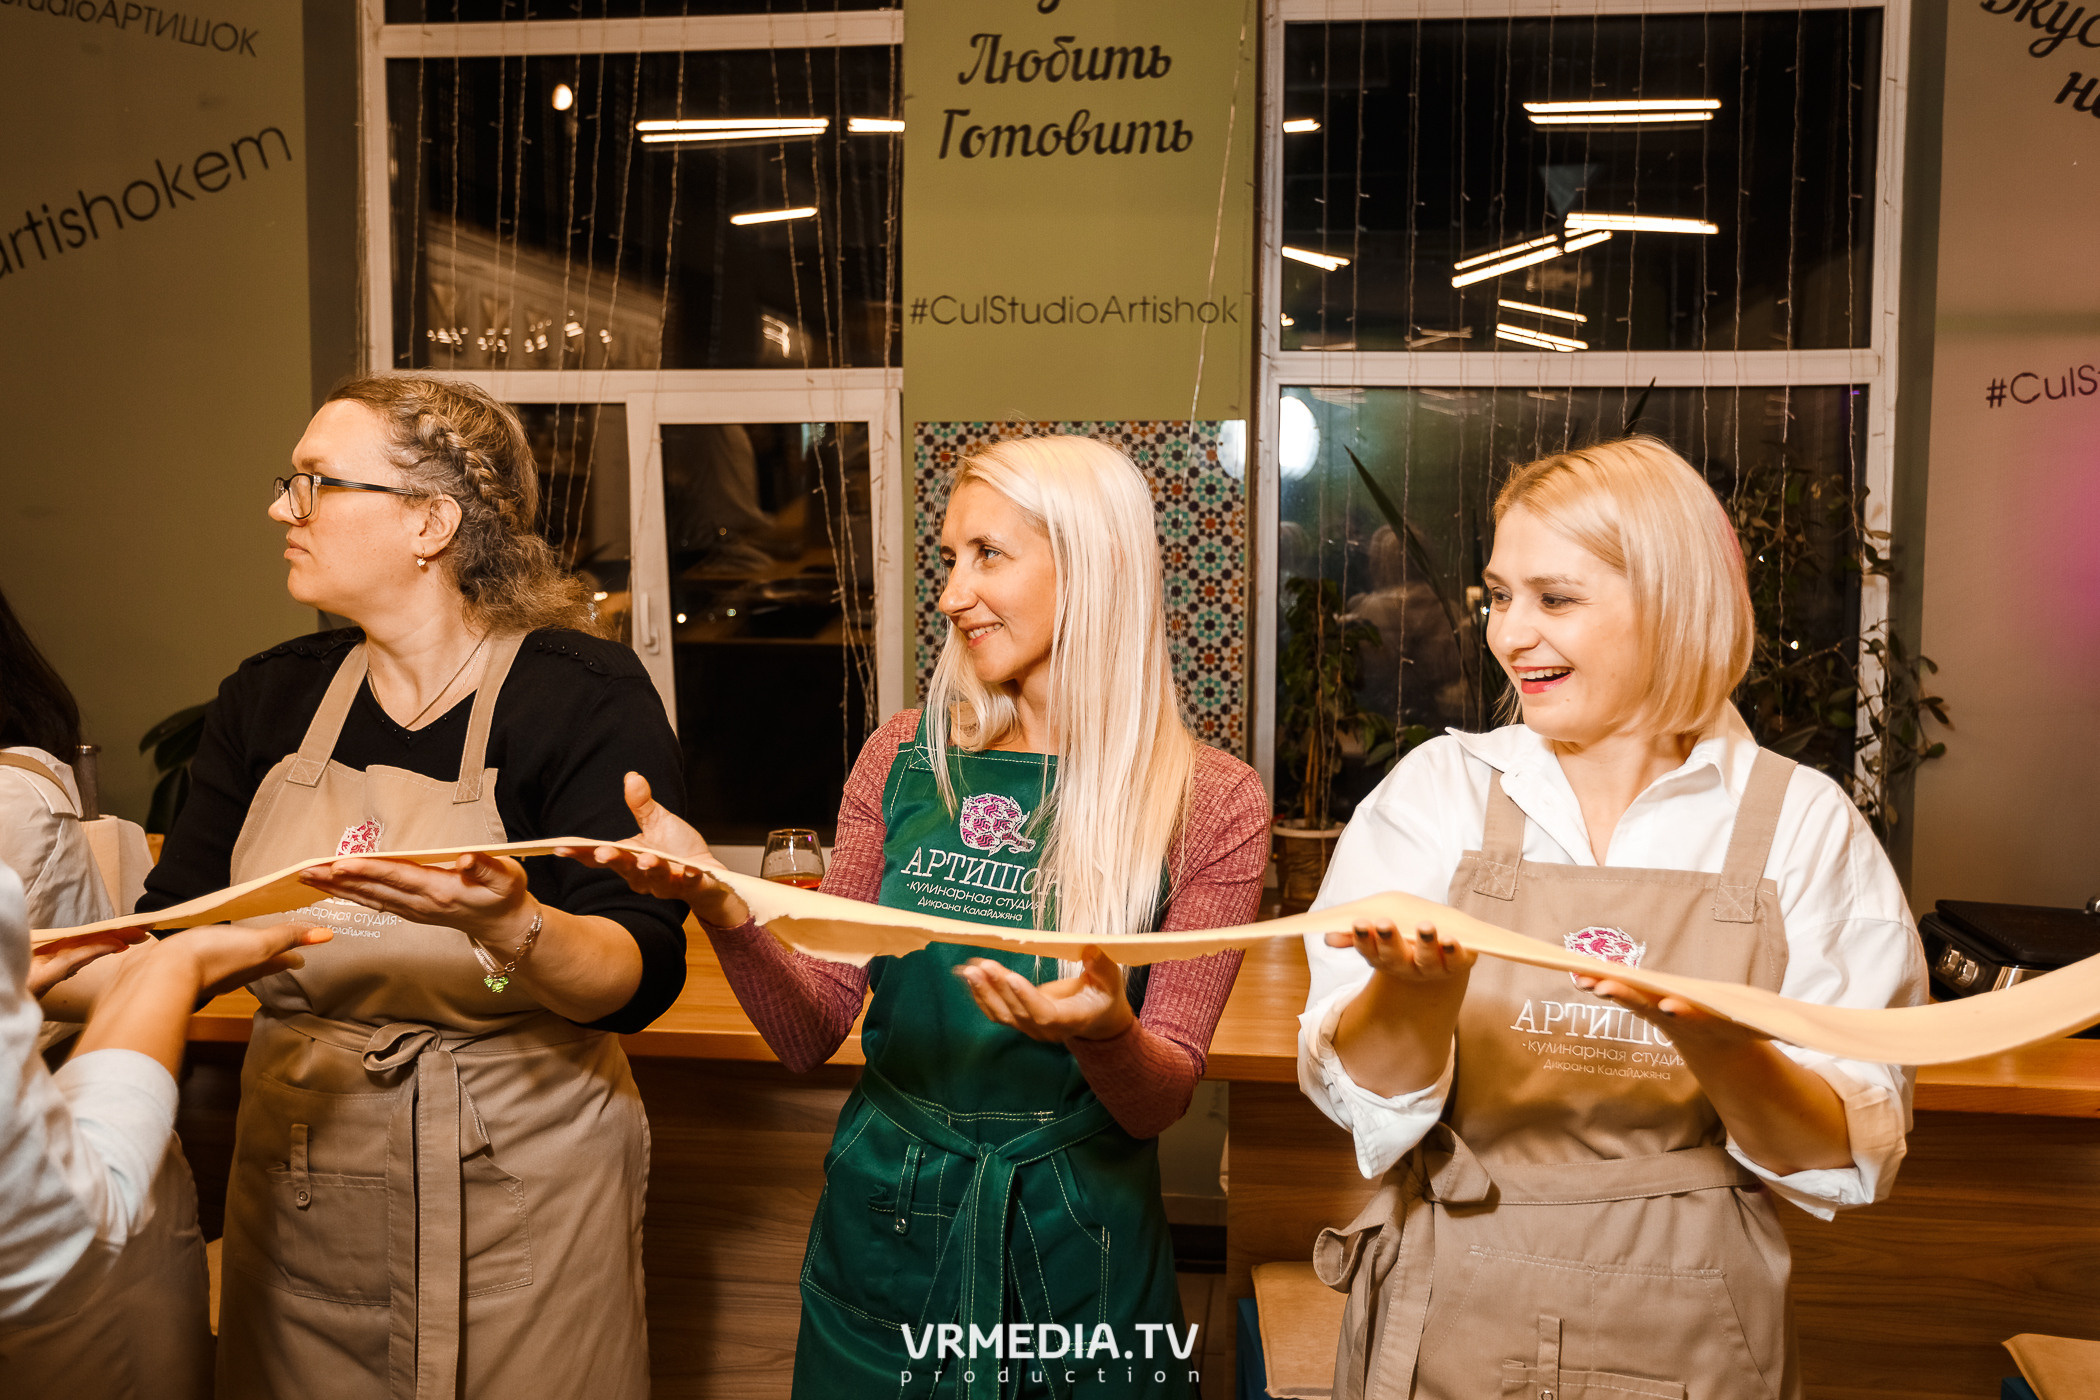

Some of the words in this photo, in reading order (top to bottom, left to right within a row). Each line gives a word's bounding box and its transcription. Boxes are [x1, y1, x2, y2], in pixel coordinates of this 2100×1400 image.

[957, 33, 1173, 85] Любить
[938, 108, 1194, 160] Готовить
[909, 295, 1239, 325] #CulStudioArtishok
[1986, 364, 2100, 408] #CulS
[917, 895, 961, 913] Дикрана
[962, 905, 1023, 921] Калайджяна
[1543, 1058, 1595, 1074] Дикрана
[1597, 1065, 1671, 1080] Калайджяна
